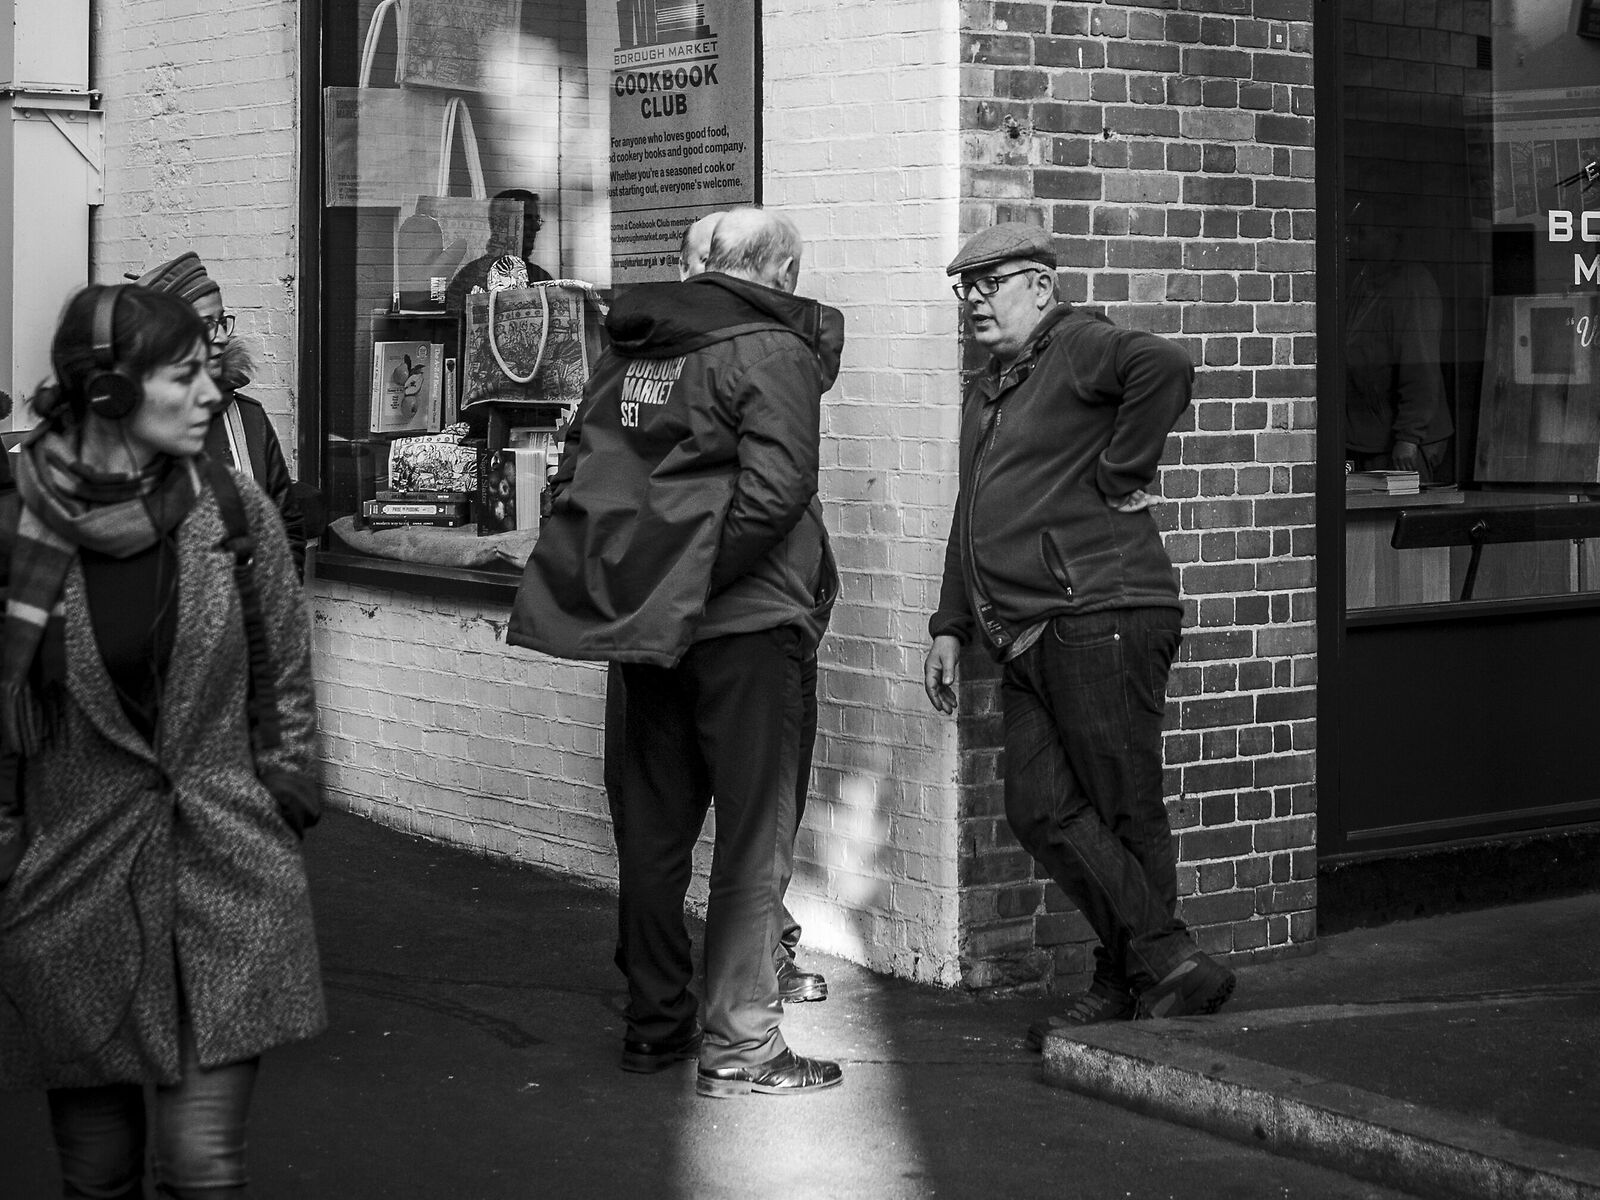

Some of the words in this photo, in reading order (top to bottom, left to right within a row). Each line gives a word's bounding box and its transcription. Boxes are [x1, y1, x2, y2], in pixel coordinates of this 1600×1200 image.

[614, 48, 665, 65] BOROUGH
[668, 41, 718, 57] MARKET
[615, 63, 719, 97] COOKBOOK
[641, 93, 688, 119] CLUB
[611, 136, 621, 148] For
[622, 135, 647, 149] anyone
[647, 132, 663, 144] who
[664, 131, 684, 143] loves
[685, 127, 706, 142] good
[707, 124, 730, 139] food,
[617, 150, 643, 164] cookery
[644, 147, 666, 160] books
[667, 145, 682, 157] and
[683, 143, 704, 158] good
[704, 141, 747, 155] company.
[610, 169, 638, 182] Whether
[660, 168, 665, 178] a
[665, 163, 703, 177] seasoned
[704, 161, 726, 175] cook
[726, 162, 735, 172] or
[619, 184, 644, 197] starting
[645, 183, 659, 195] out,
[660, 178, 702, 194] everyone's
[703, 176, 743, 190] welcome.
[629, 219, 656, 230] Cookbook
[656, 217, 670, 228] Club
[621, 377, 675, 405] MARKET
[620, 401, 640, 427] SE1
